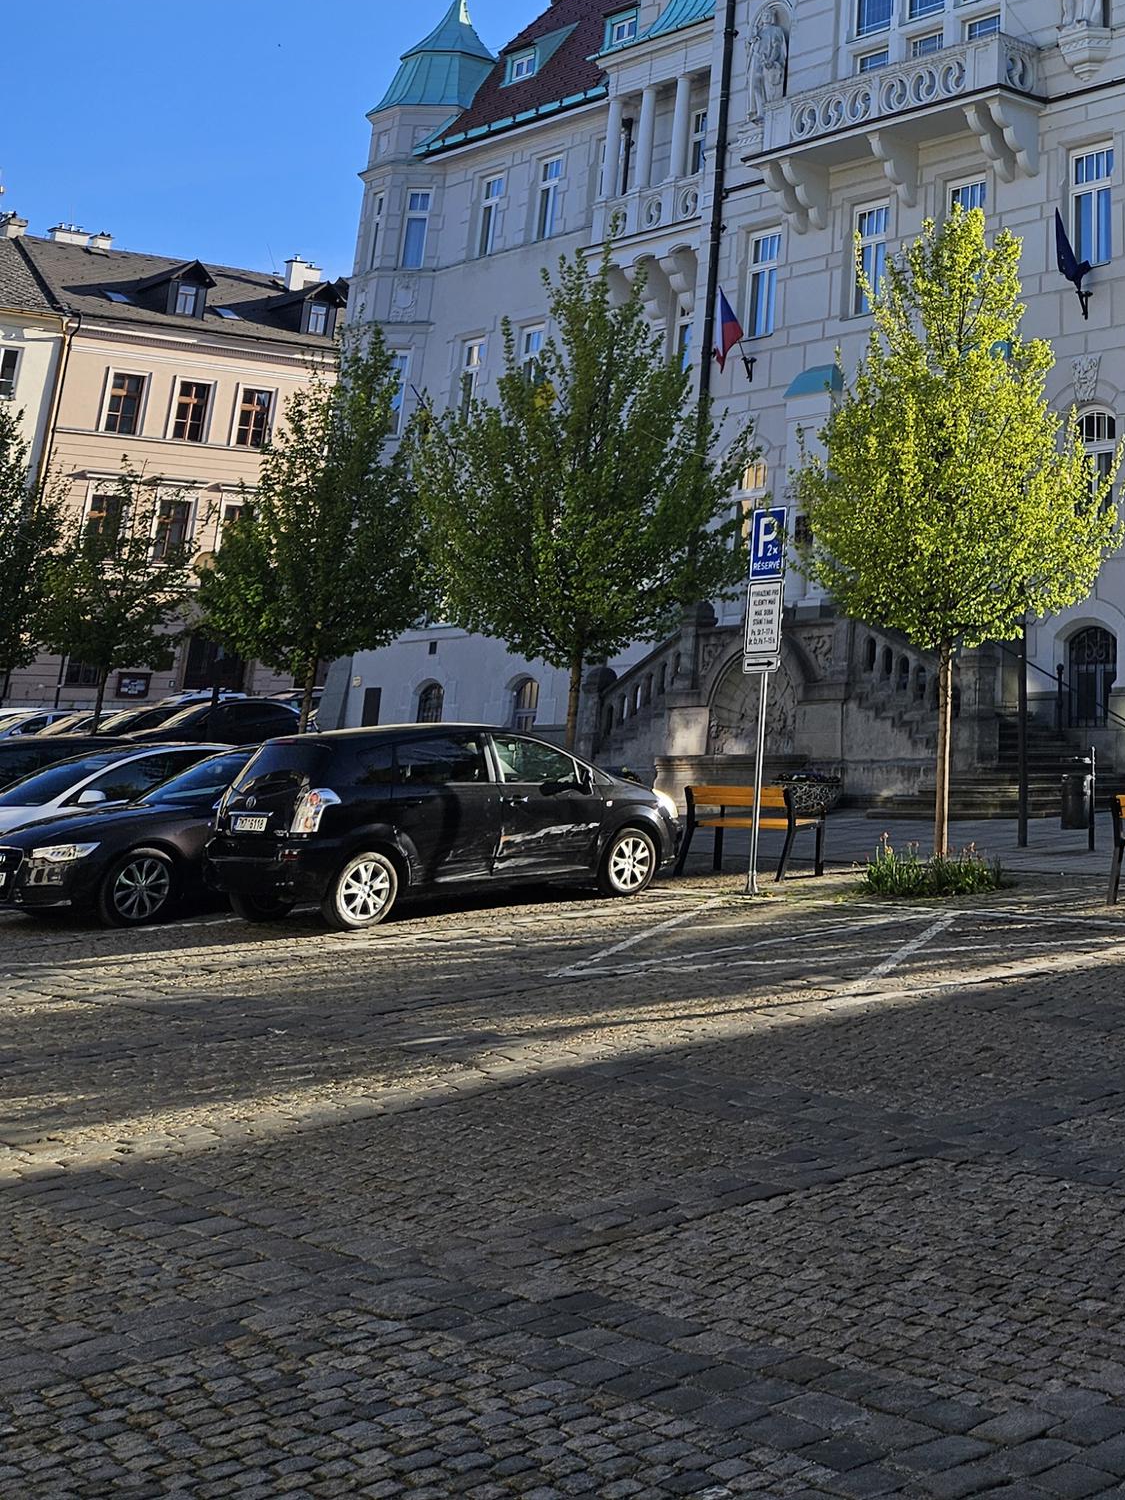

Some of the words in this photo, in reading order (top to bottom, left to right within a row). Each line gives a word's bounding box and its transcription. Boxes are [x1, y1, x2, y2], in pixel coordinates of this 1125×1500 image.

[758, 516, 778, 557] P
[767, 544, 778, 556] 2x
[753, 558, 780, 570] RÉSERVÉ
